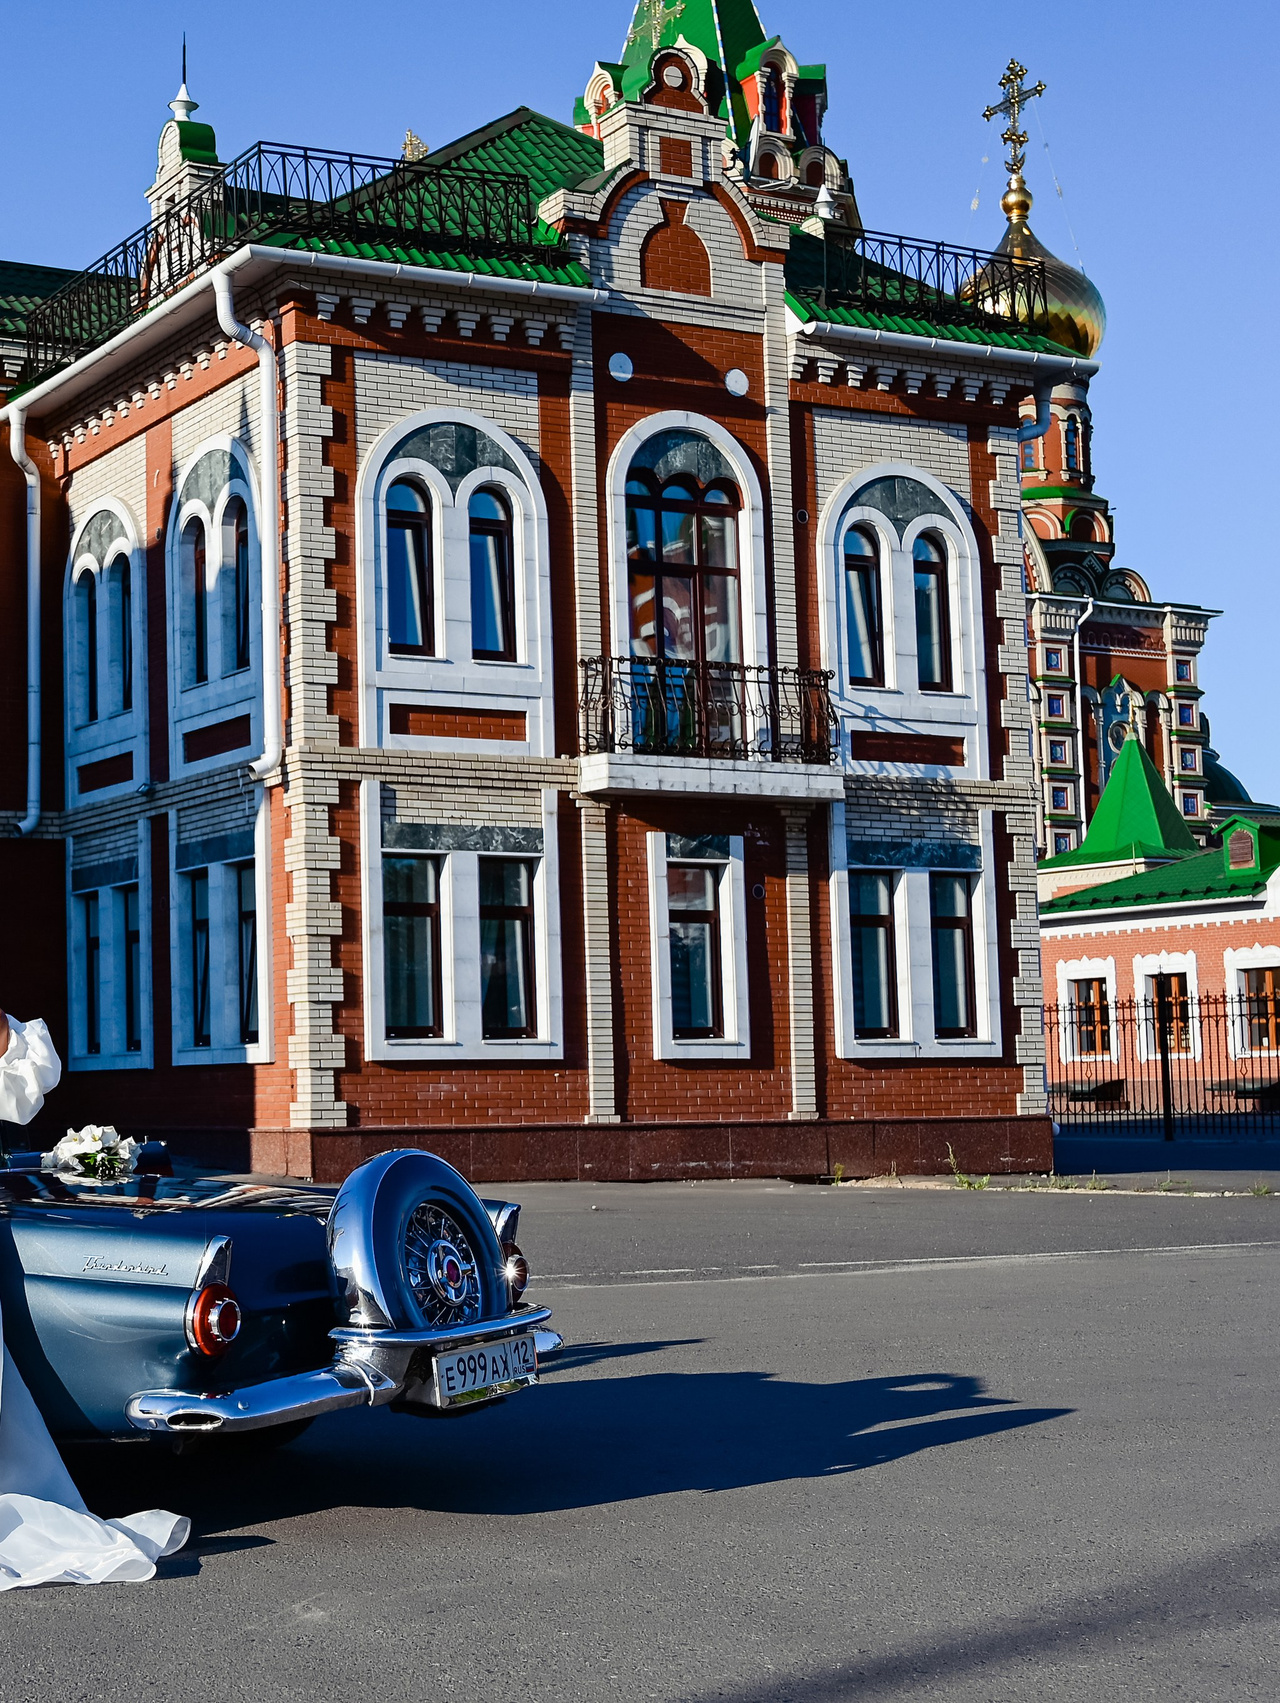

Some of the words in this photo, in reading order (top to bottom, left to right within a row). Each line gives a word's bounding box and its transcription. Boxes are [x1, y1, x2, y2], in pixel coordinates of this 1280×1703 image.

[82, 1254, 169, 1276] Thunderbird
[513, 1341, 529, 1364] 12
[513, 1365, 526, 1375] RUS
